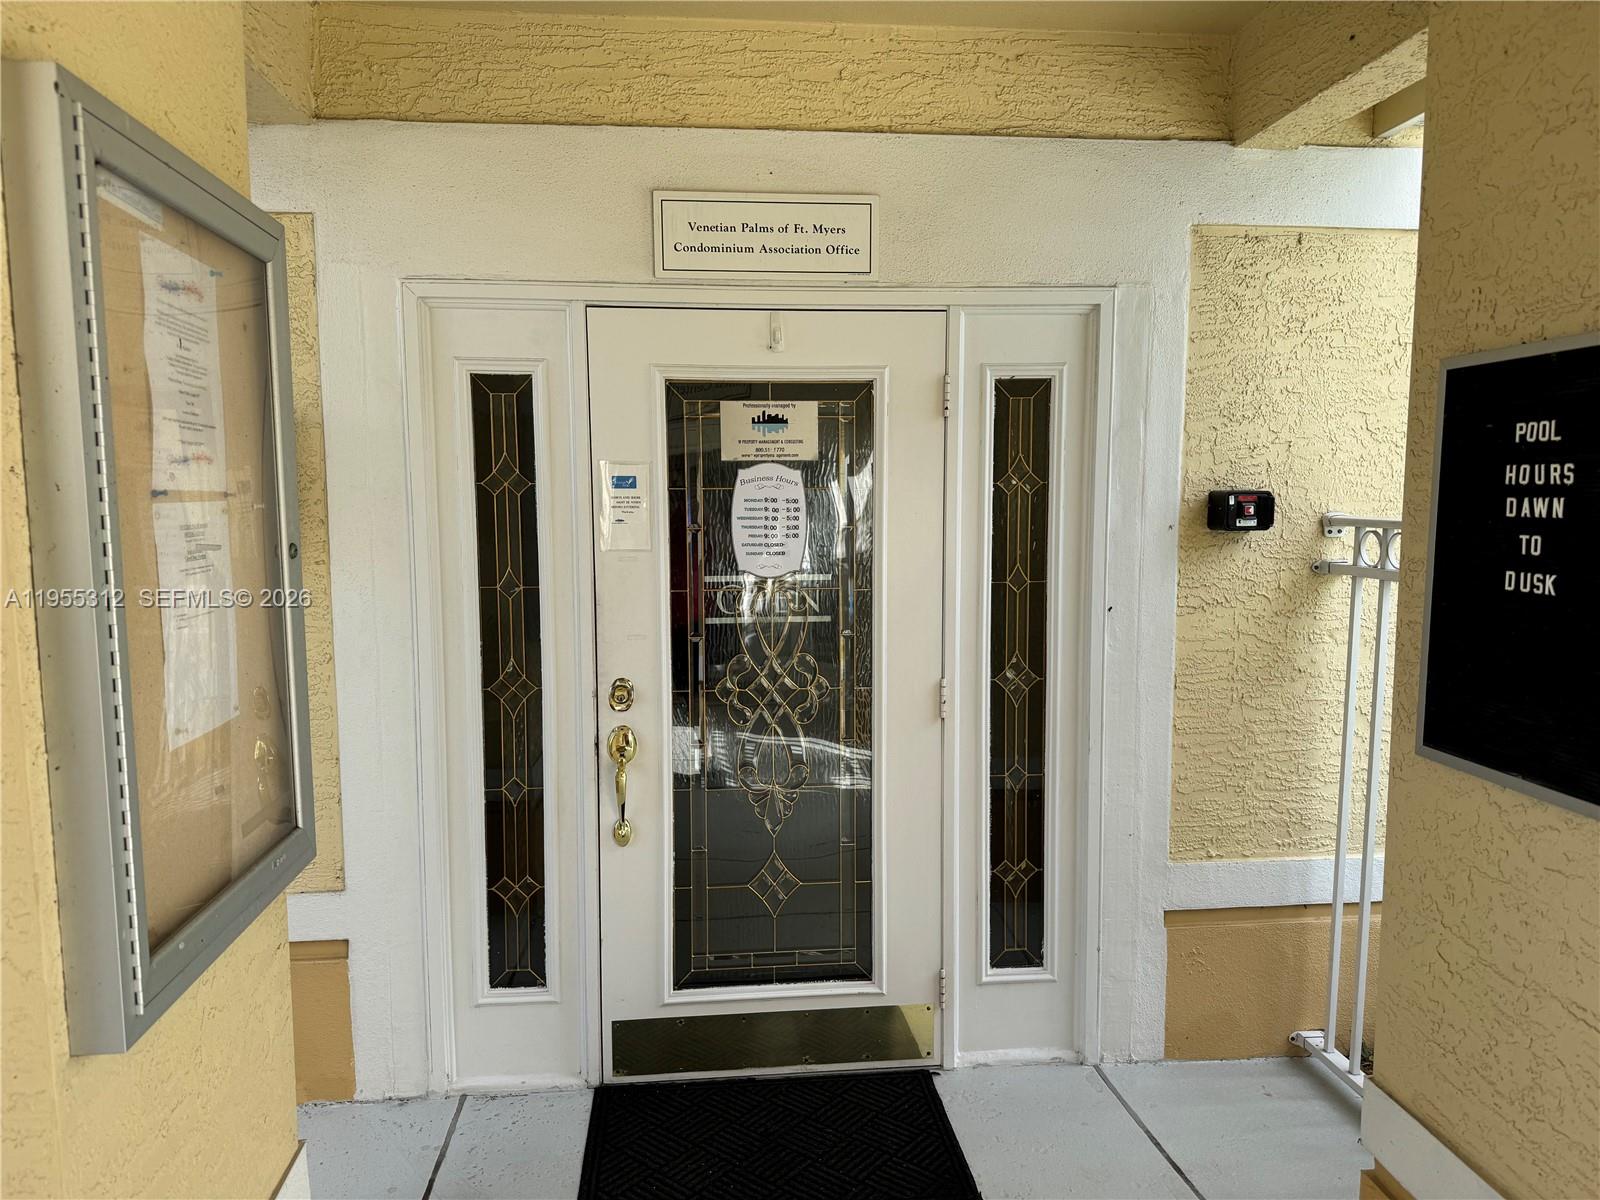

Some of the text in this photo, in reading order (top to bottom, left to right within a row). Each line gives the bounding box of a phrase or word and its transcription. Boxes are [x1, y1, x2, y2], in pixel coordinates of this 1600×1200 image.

[688, 221, 846, 236] Venetian Palms of Ft. Myers
[673, 242, 860, 255] Condominium Association Office
[1515, 419, 1562, 443] POOL
[739, 474, 799, 487] Business Hours
[1505, 462, 1575, 486] HOURS
[1505, 496, 1565, 519] DAWN
[1519, 534, 1542, 556] TO
[1504, 570, 1558, 597] DUSK
